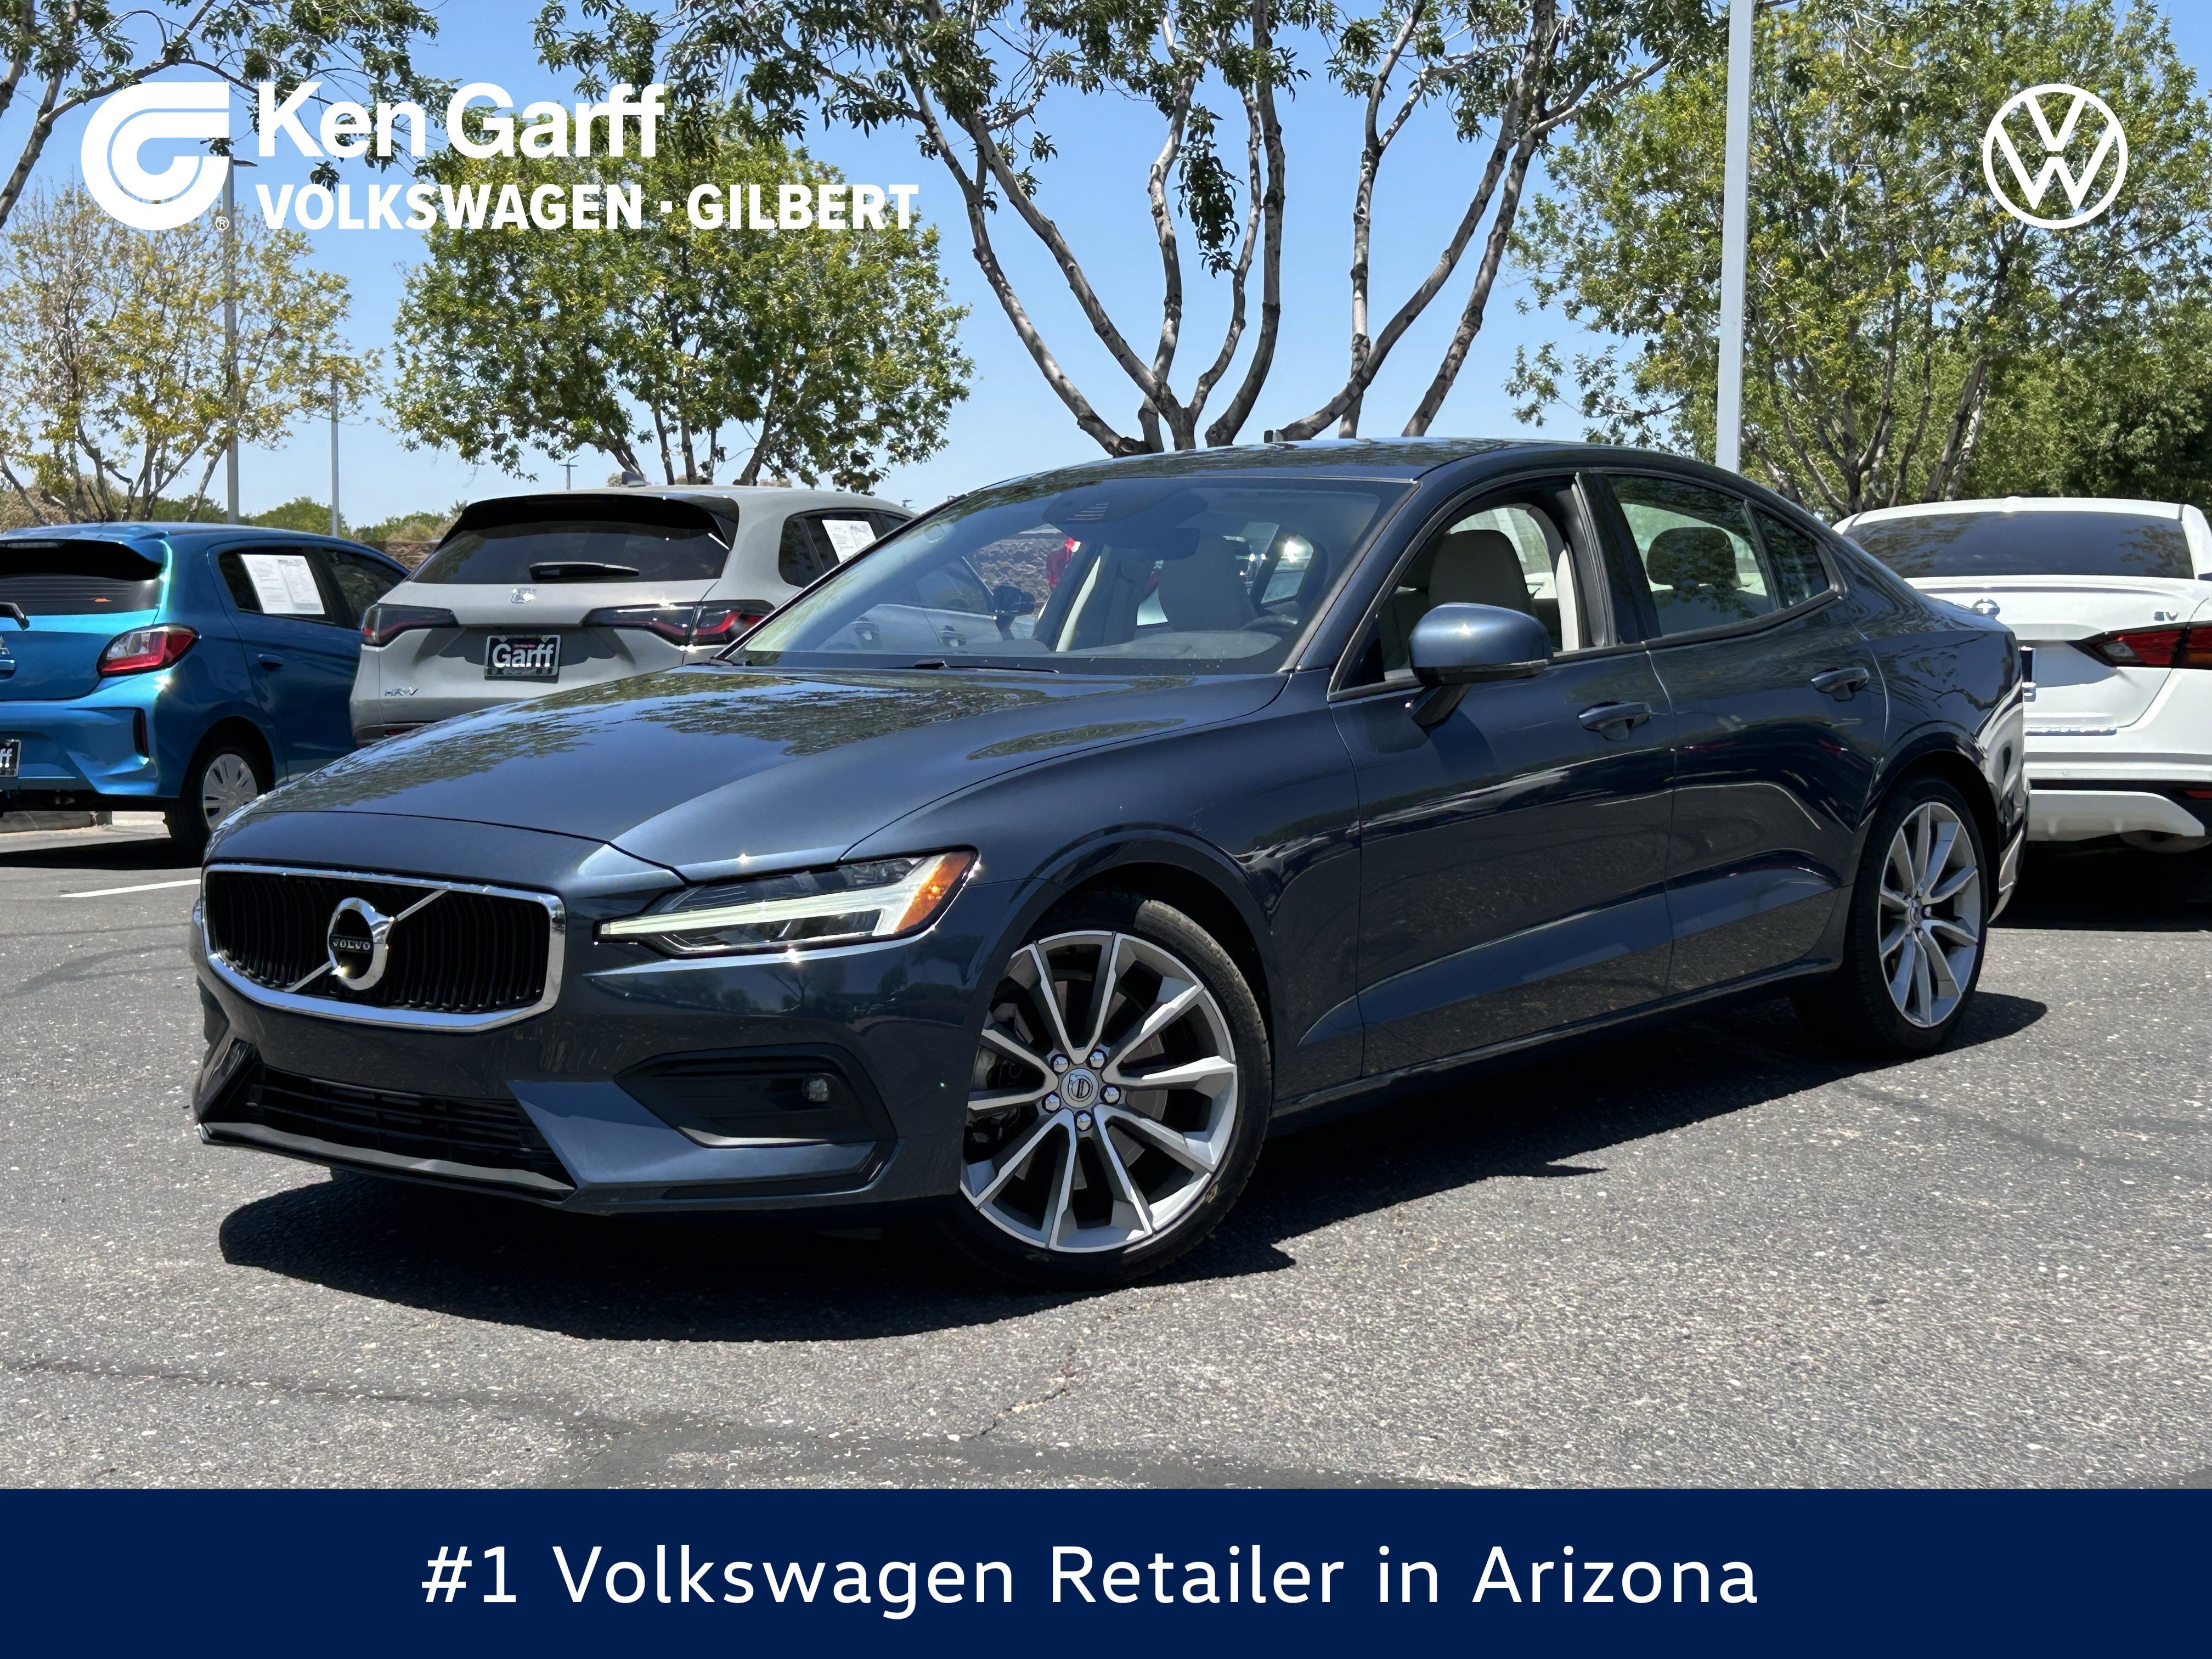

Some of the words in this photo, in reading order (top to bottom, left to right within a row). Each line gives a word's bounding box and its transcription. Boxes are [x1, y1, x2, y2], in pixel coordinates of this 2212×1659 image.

[2154, 611, 2178, 621] V
[492, 643, 554, 668] Garff
[332, 938, 371, 951] VOLVO
